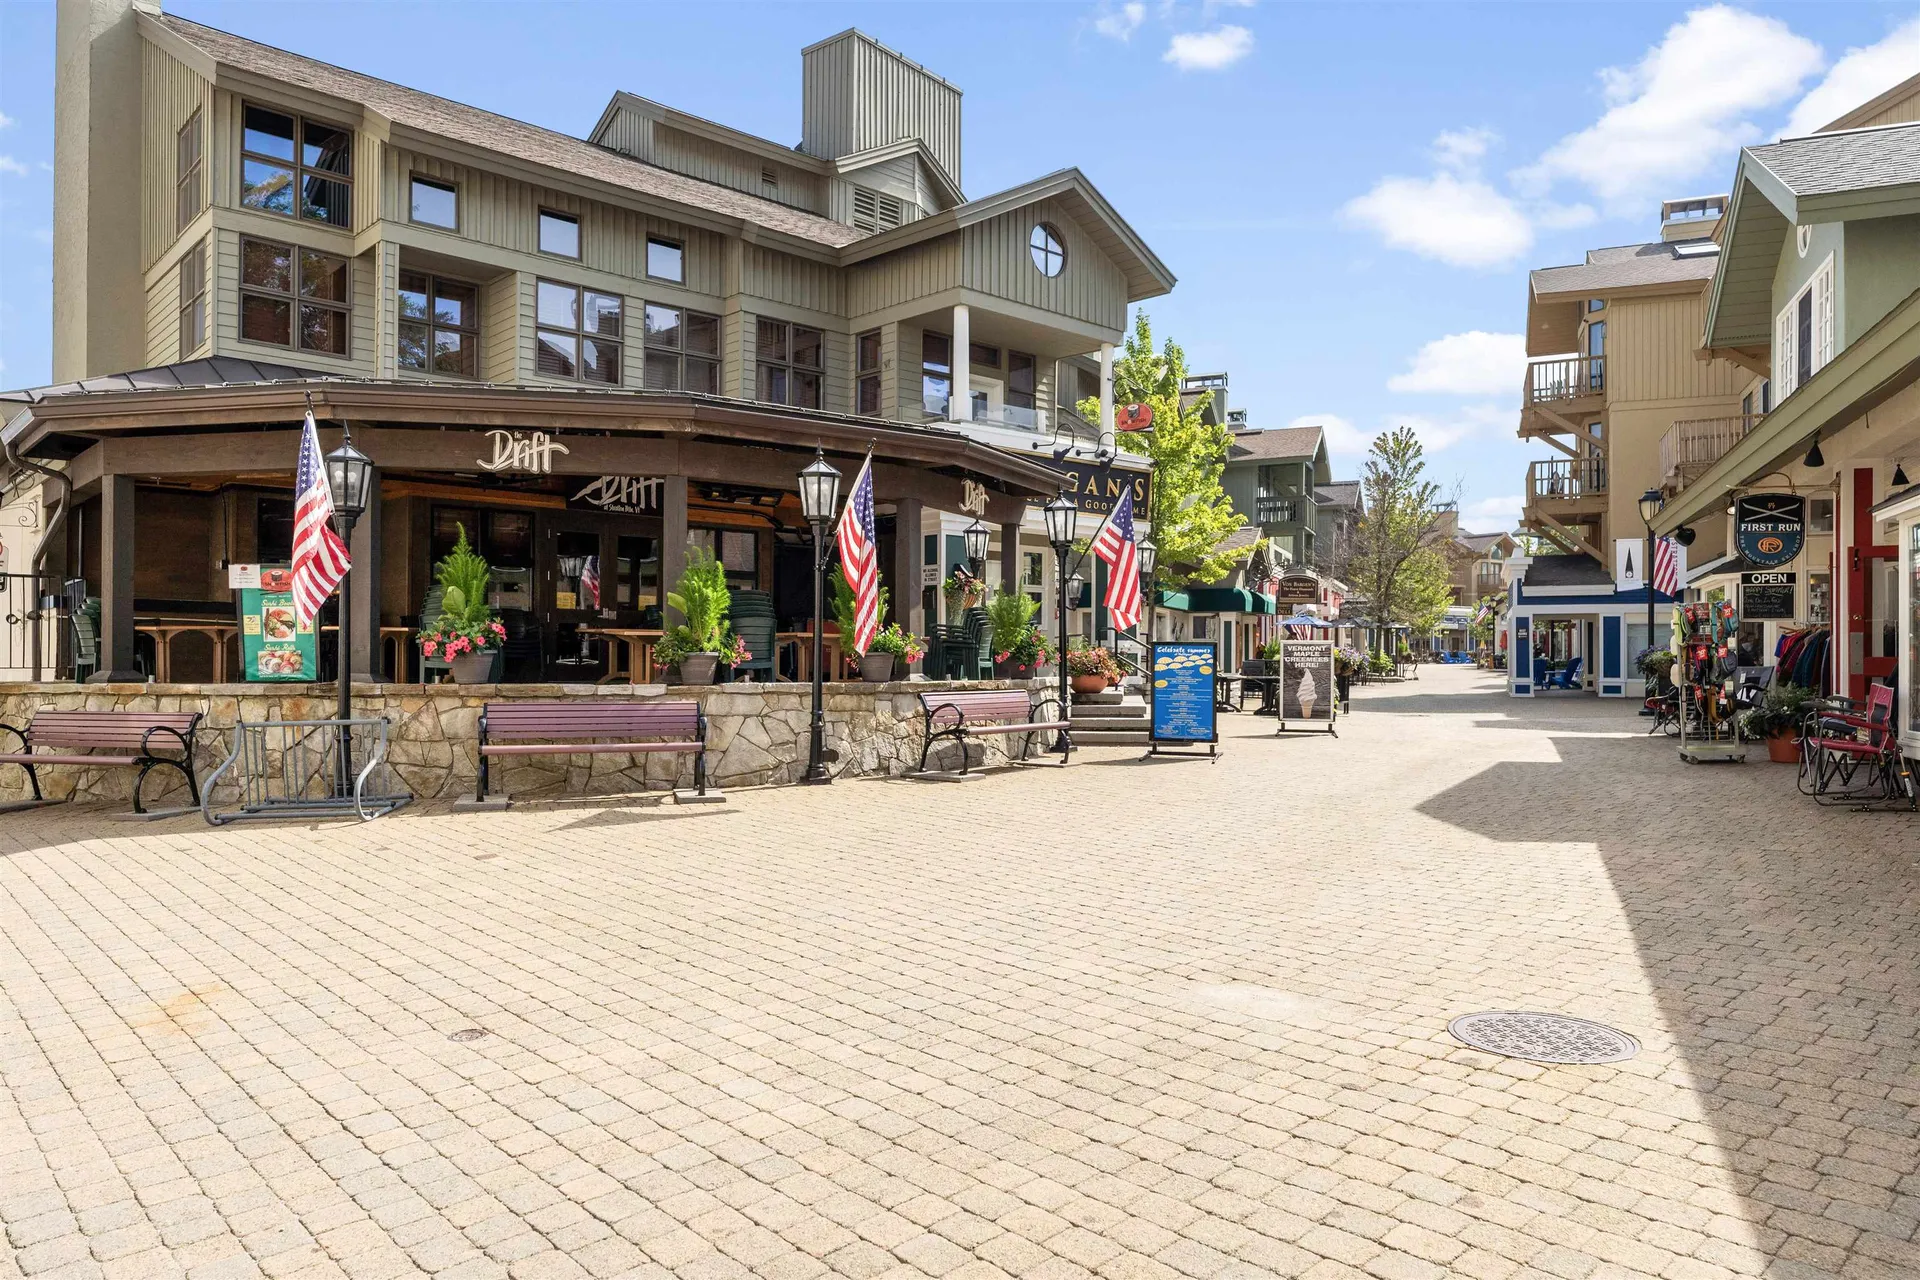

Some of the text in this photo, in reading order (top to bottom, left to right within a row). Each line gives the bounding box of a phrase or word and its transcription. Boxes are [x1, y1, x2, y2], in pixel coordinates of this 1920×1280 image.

[514, 431, 523, 440] the
[476, 429, 570, 474] Drift
[1741, 523, 1801, 532] FIRST RUN
[1751, 573, 1787, 584] OPEN
